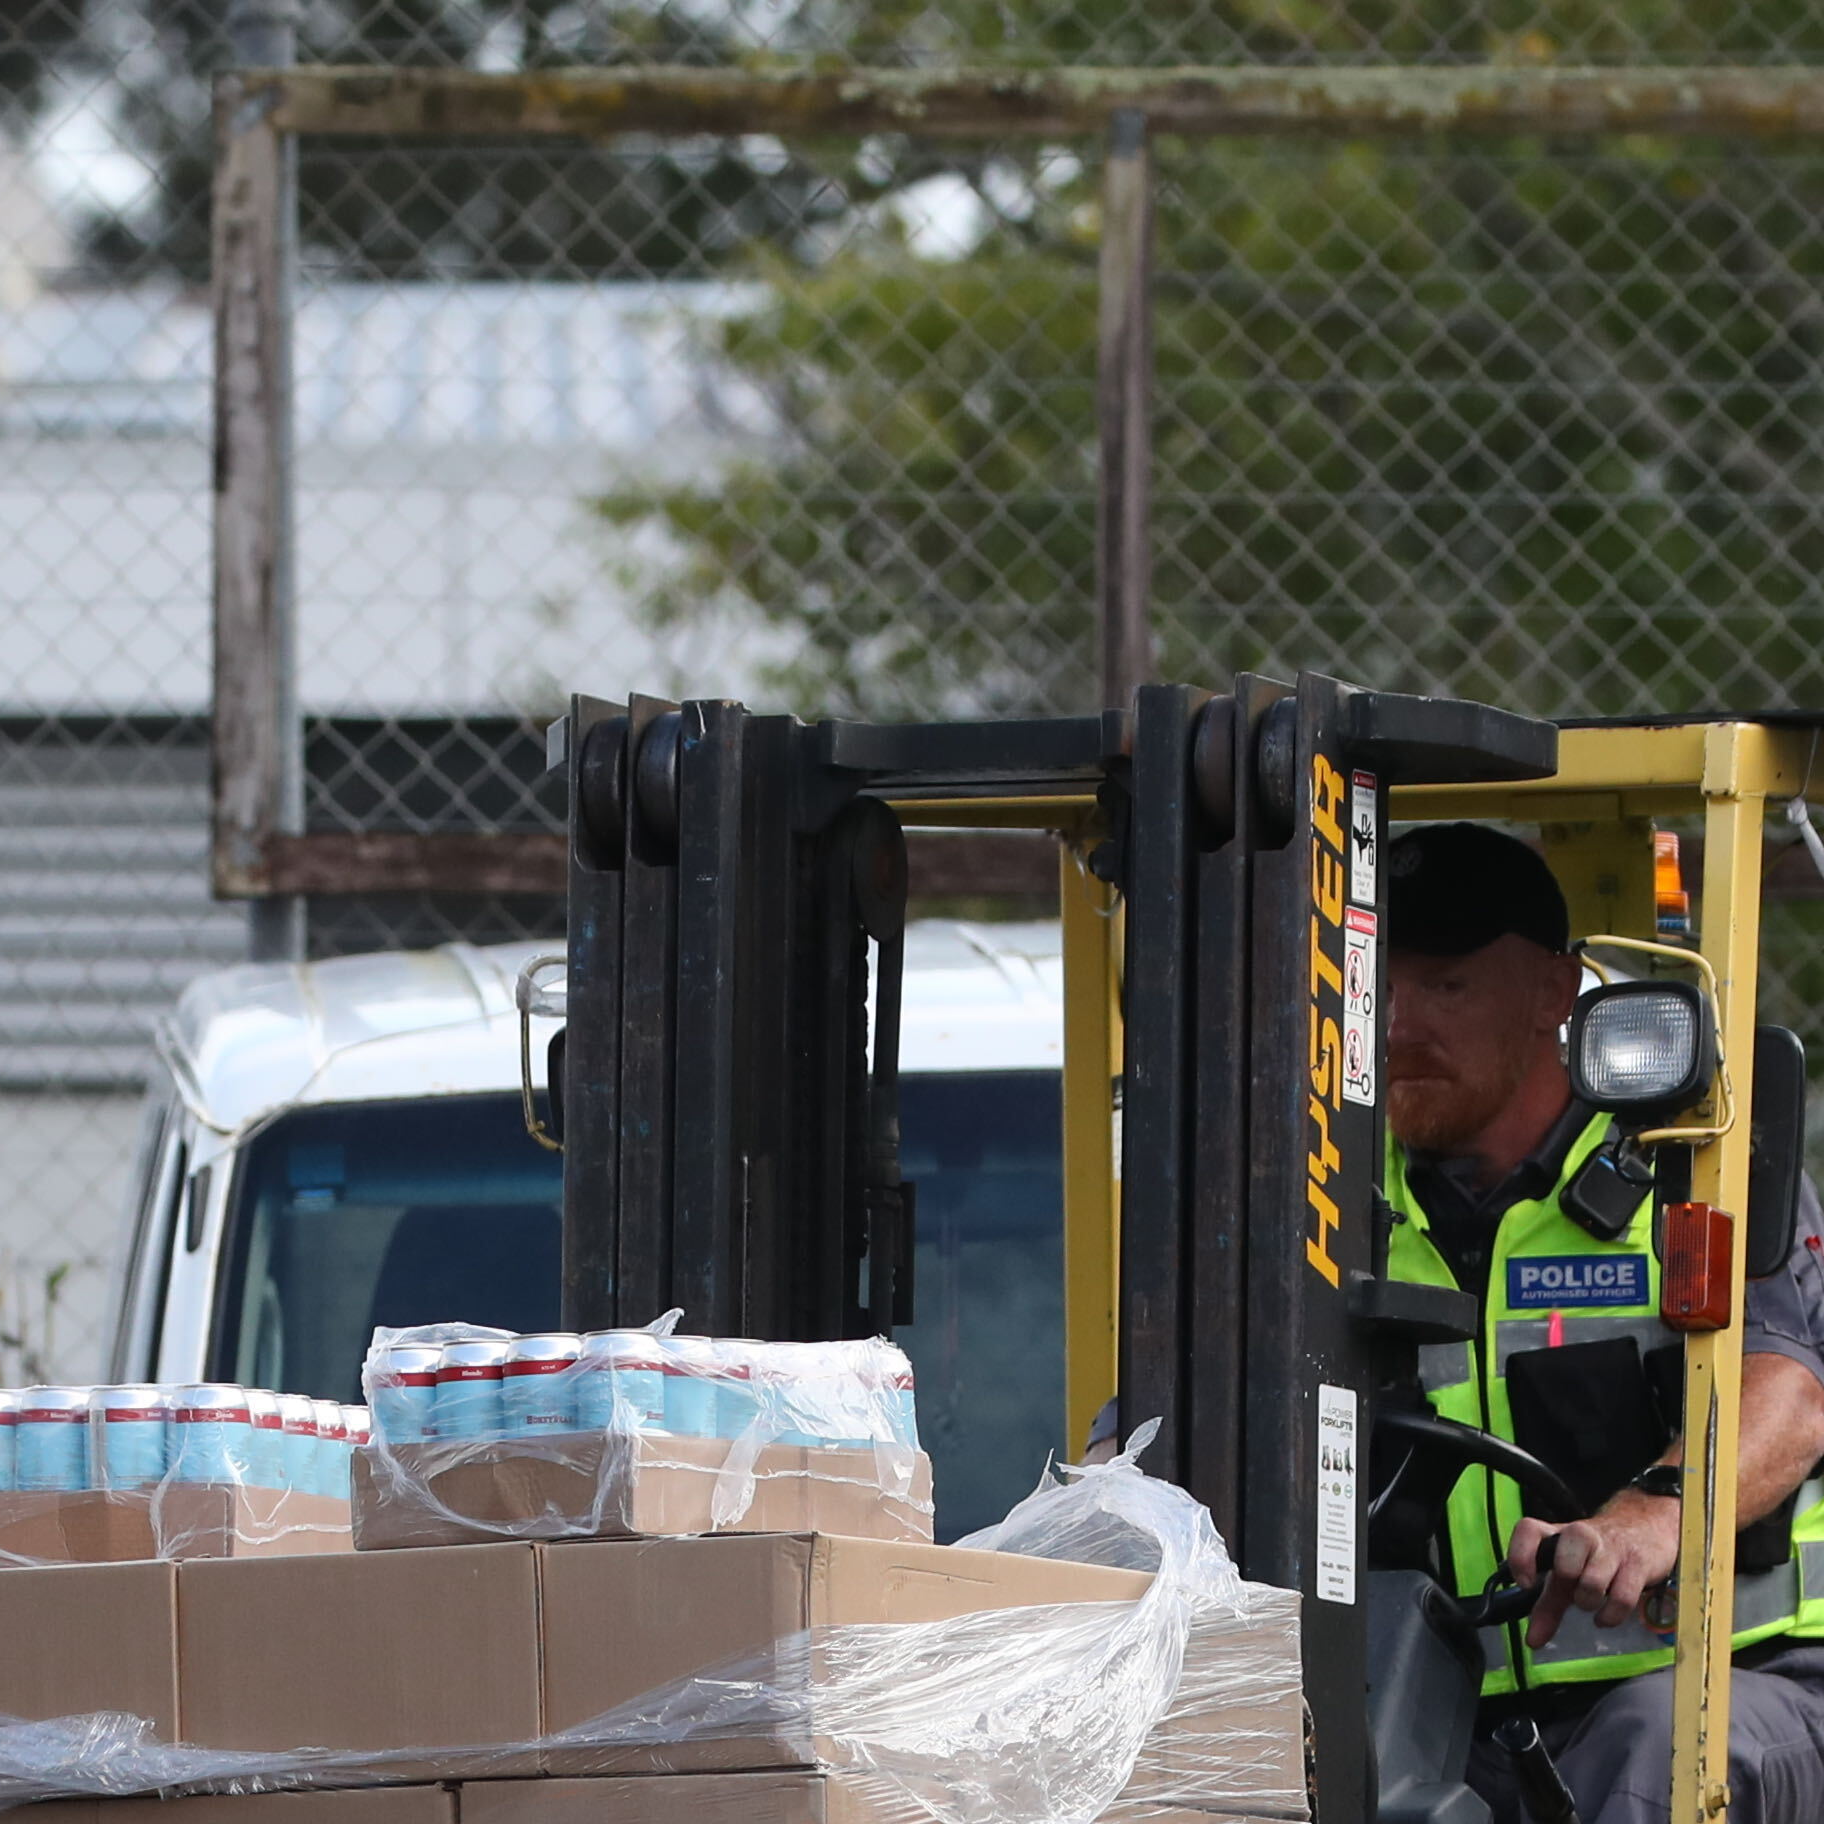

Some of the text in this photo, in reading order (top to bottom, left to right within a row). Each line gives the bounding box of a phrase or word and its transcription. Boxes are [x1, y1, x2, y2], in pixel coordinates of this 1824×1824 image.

[1307, 753, 1344, 1289] HYSTER
[1520, 1263, 1635, 1288] POLICE
[1521, 1287, 1636, 1299] AUTHORISED OFFICER
[1320, 1416, 1353, 1431] FORKLIFTS
